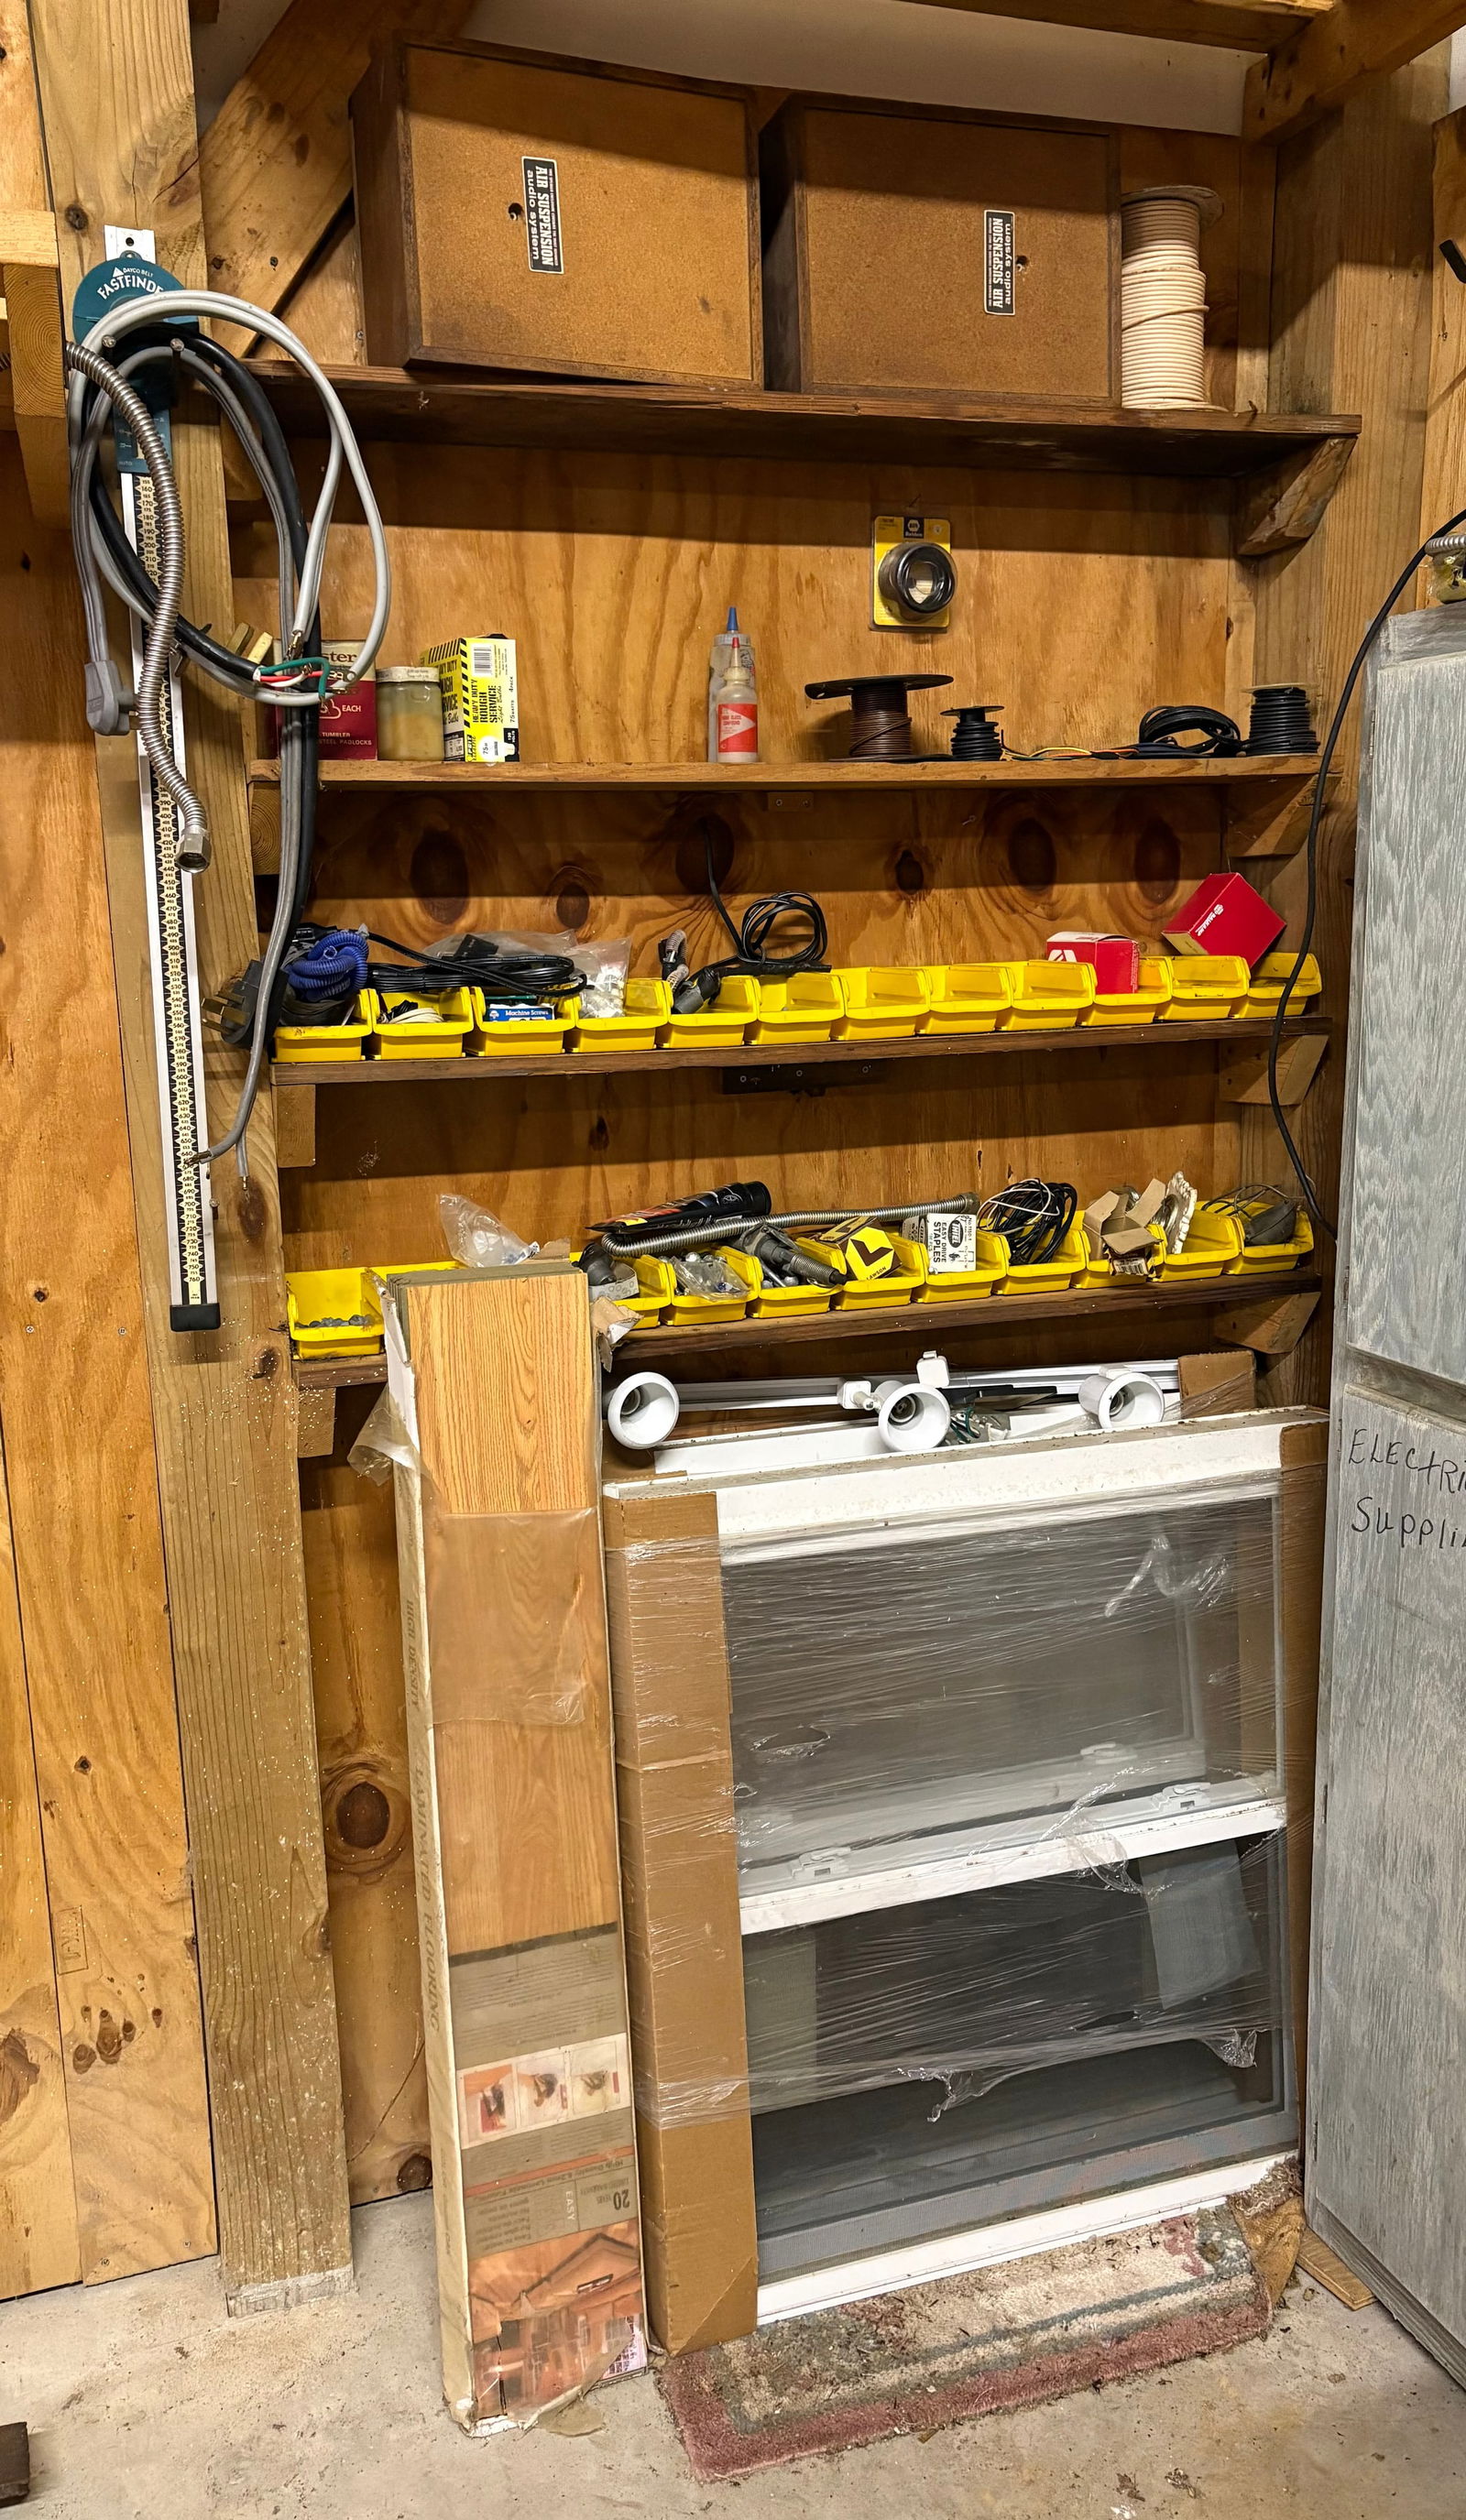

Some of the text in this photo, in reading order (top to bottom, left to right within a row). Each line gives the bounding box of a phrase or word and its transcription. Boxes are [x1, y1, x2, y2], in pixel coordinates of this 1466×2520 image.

[527, 169, 540, 260] audio system
[535, 166, 553, 266] AIR SUSPENSION
[992, 218, 1003, 308] AIR SUSPENSION
[1004, 224, 1012, 267] system
[141, 269, 154, 278] BELT
[479, 692, 488, 723] ROUGH
[487, 685, 498, 723] SERVICE
[933, 1221, 941, 1263] STAPLES
[951, 1223, 961, 1244] THIEL
[866, 1266, 887, 1281] LAWSON
[1351, 1497, 1466, 1549] Suppli
[406, 1598, 420, 1712] HIGH DENSITY
[415, 1768, 441, 2033] LAMINATED FLOORING
[565, 2190, 575, 2220] EASY
[613, 2188, 630, 2210] 20
